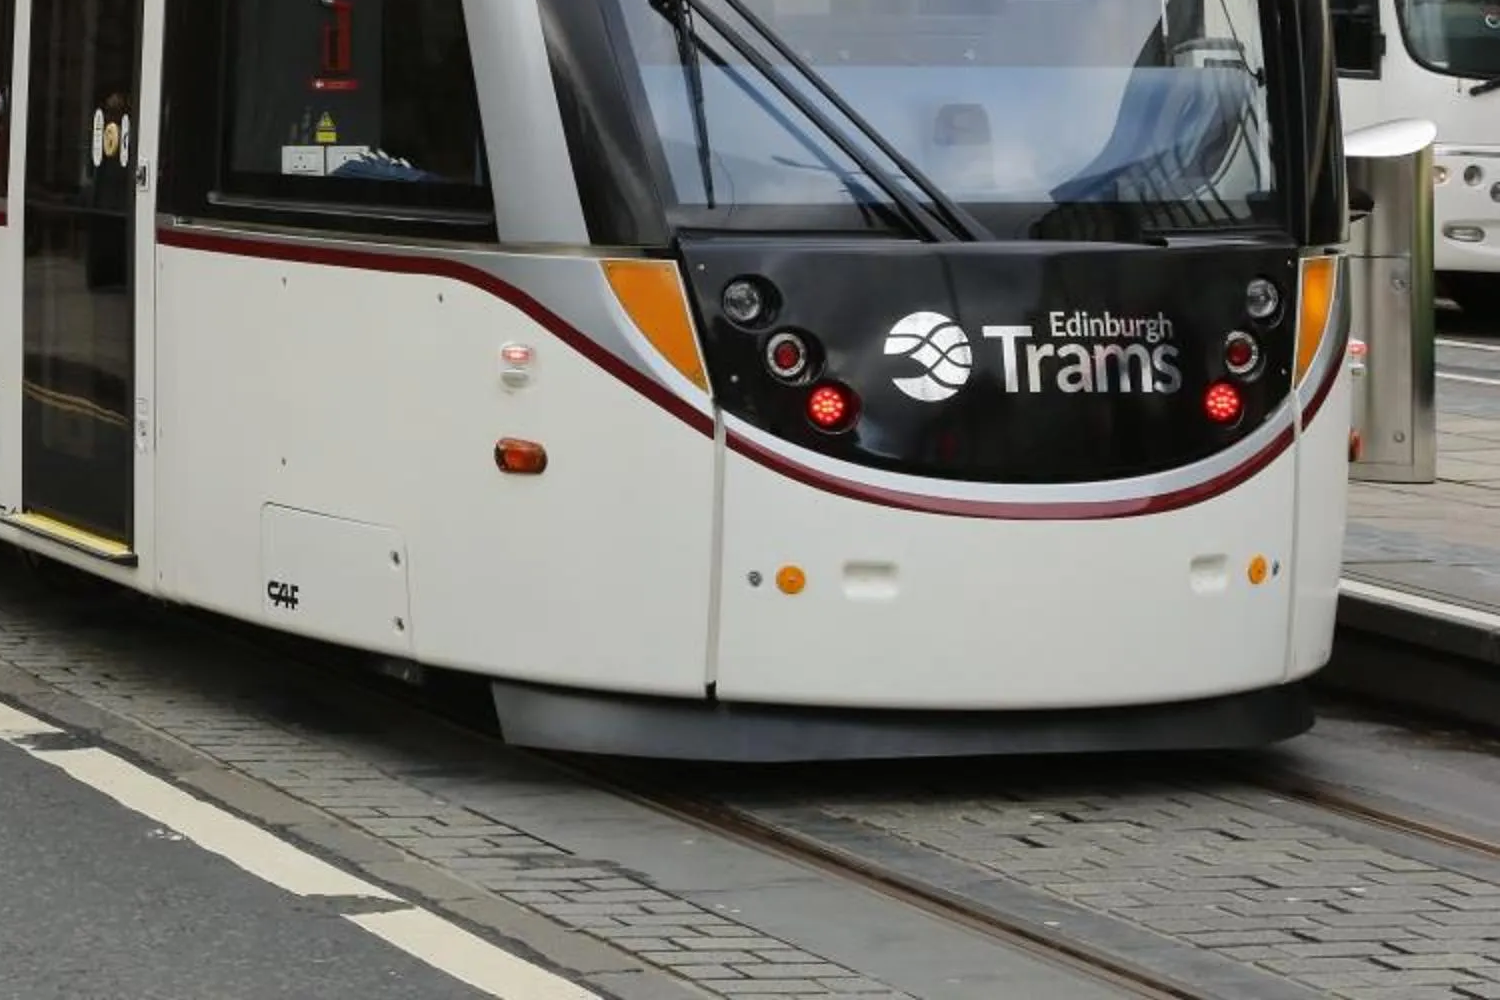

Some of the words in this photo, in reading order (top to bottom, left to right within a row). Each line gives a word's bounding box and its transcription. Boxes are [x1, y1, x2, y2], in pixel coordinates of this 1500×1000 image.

[1049, 311, 1174, 343] Edinburgh
[982, 325, 1183, 394] Trams
[267, 580, 299, 610] CAF
